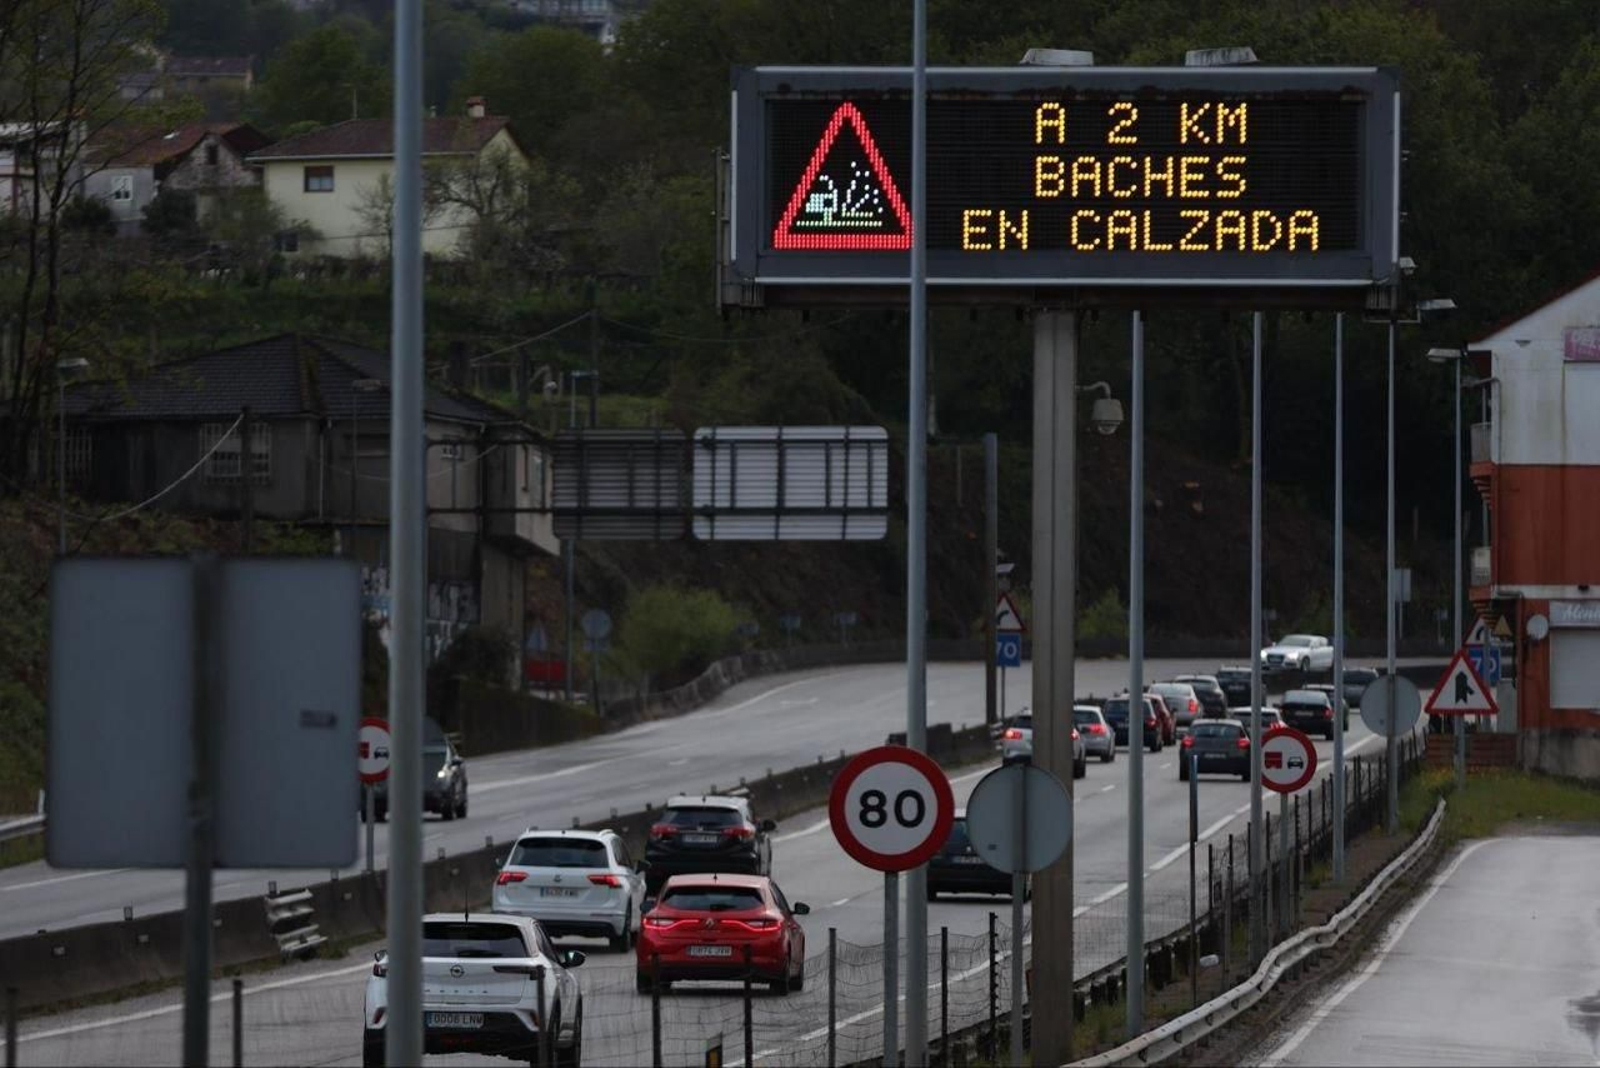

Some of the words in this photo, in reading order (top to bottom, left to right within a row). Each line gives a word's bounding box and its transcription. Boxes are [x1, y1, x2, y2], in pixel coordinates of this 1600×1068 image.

[1035, 102, 1066, 143] A
[1107, 102, 1138, 143] 2
[1180, 102, 1248, 143] KM
[1035, 156, 1248, 197] BACHES
[962, 209, 1029, 250] EN
[1070, 209, 1319, 250] CALZADA
[859, 789, 925, 828] 80
